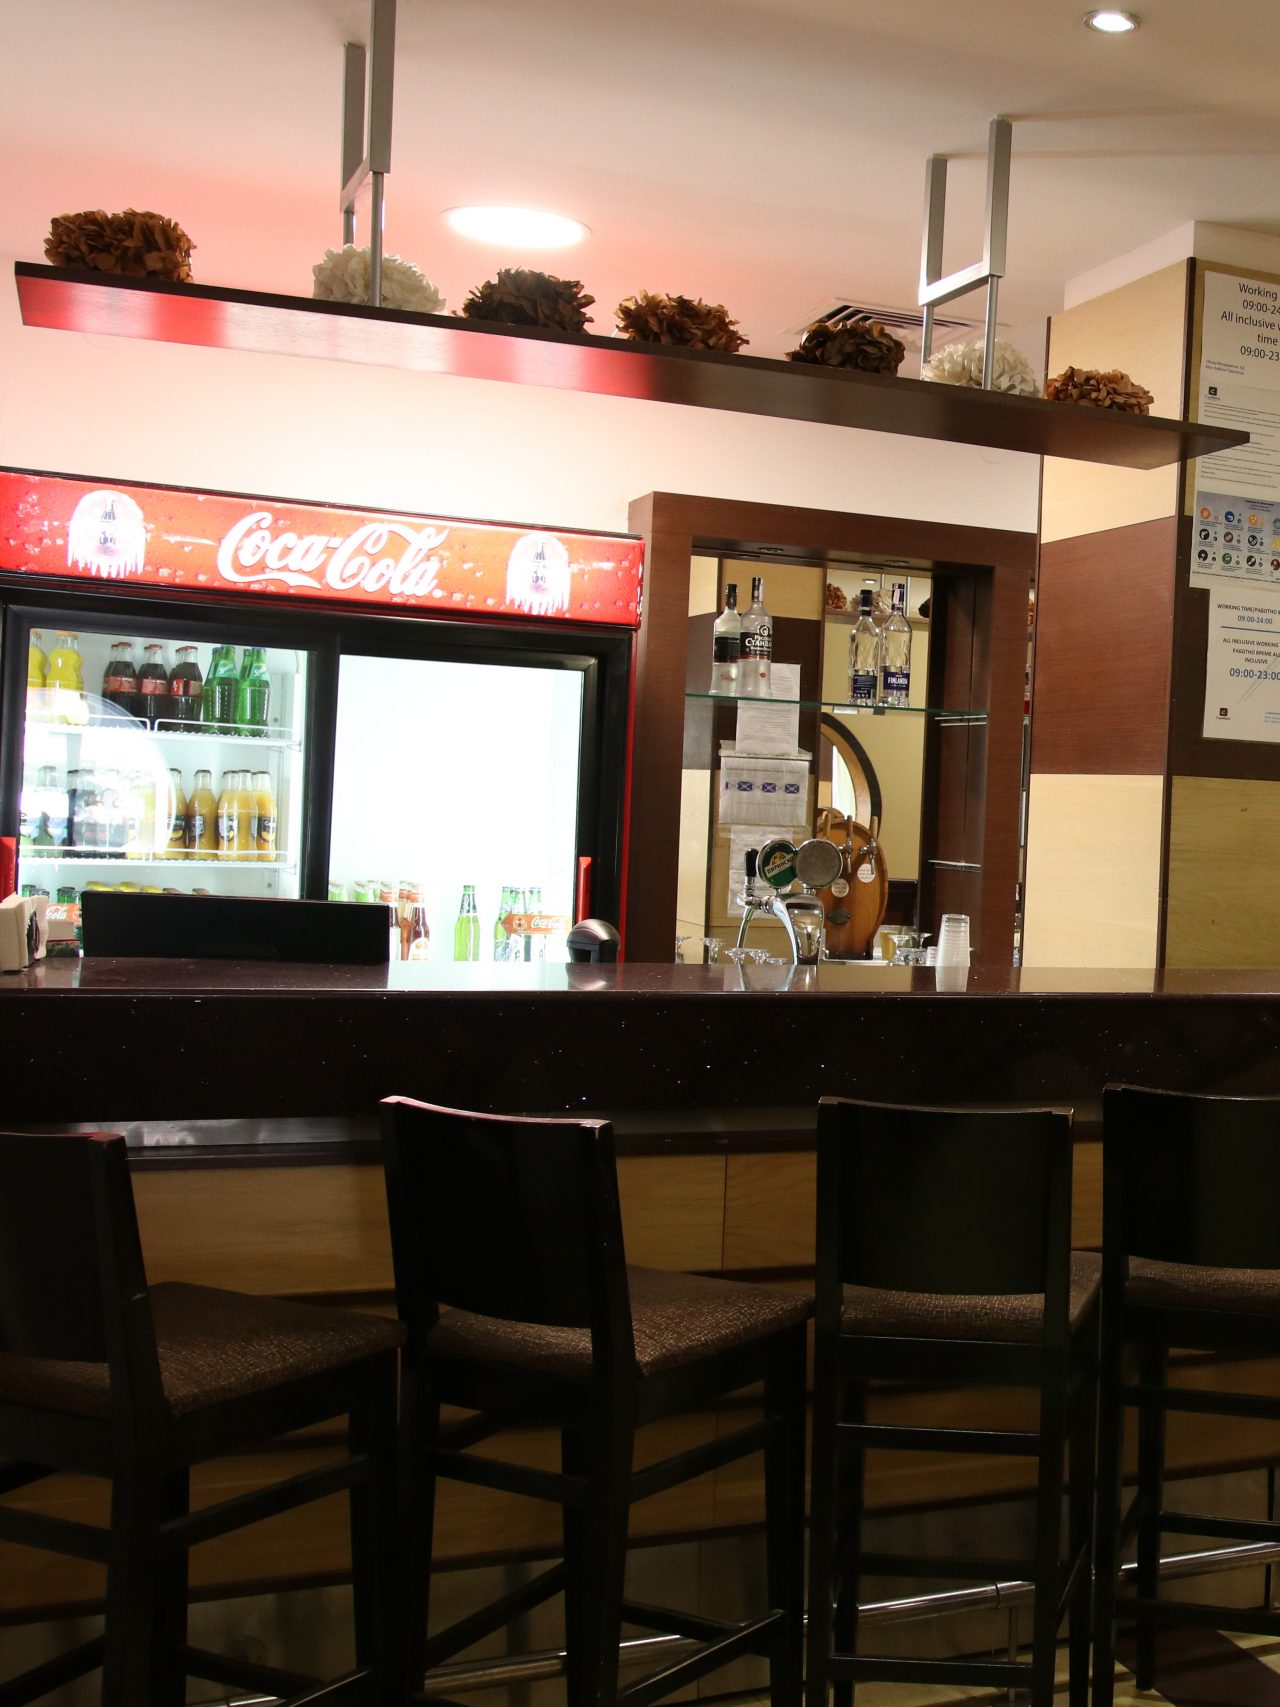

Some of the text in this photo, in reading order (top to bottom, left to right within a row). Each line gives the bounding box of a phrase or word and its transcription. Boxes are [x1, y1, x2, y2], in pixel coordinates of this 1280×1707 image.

[1238, 283, 1278, 301] Working
[1221, 310, 1233, 322] All
[1235, 313, 1276, 330] inclusive
[1257, 333, 1279, 346] time
[217, 511, 449, 597] Coca-Cola
[1217, 603, 1241, 611] WORKING
[1231, 638, 1255, 646] INCLUSIVE
[1256, 640, 1279, 648] WORKING
[1244, 657, 1268, 665] INCLUSIVE
